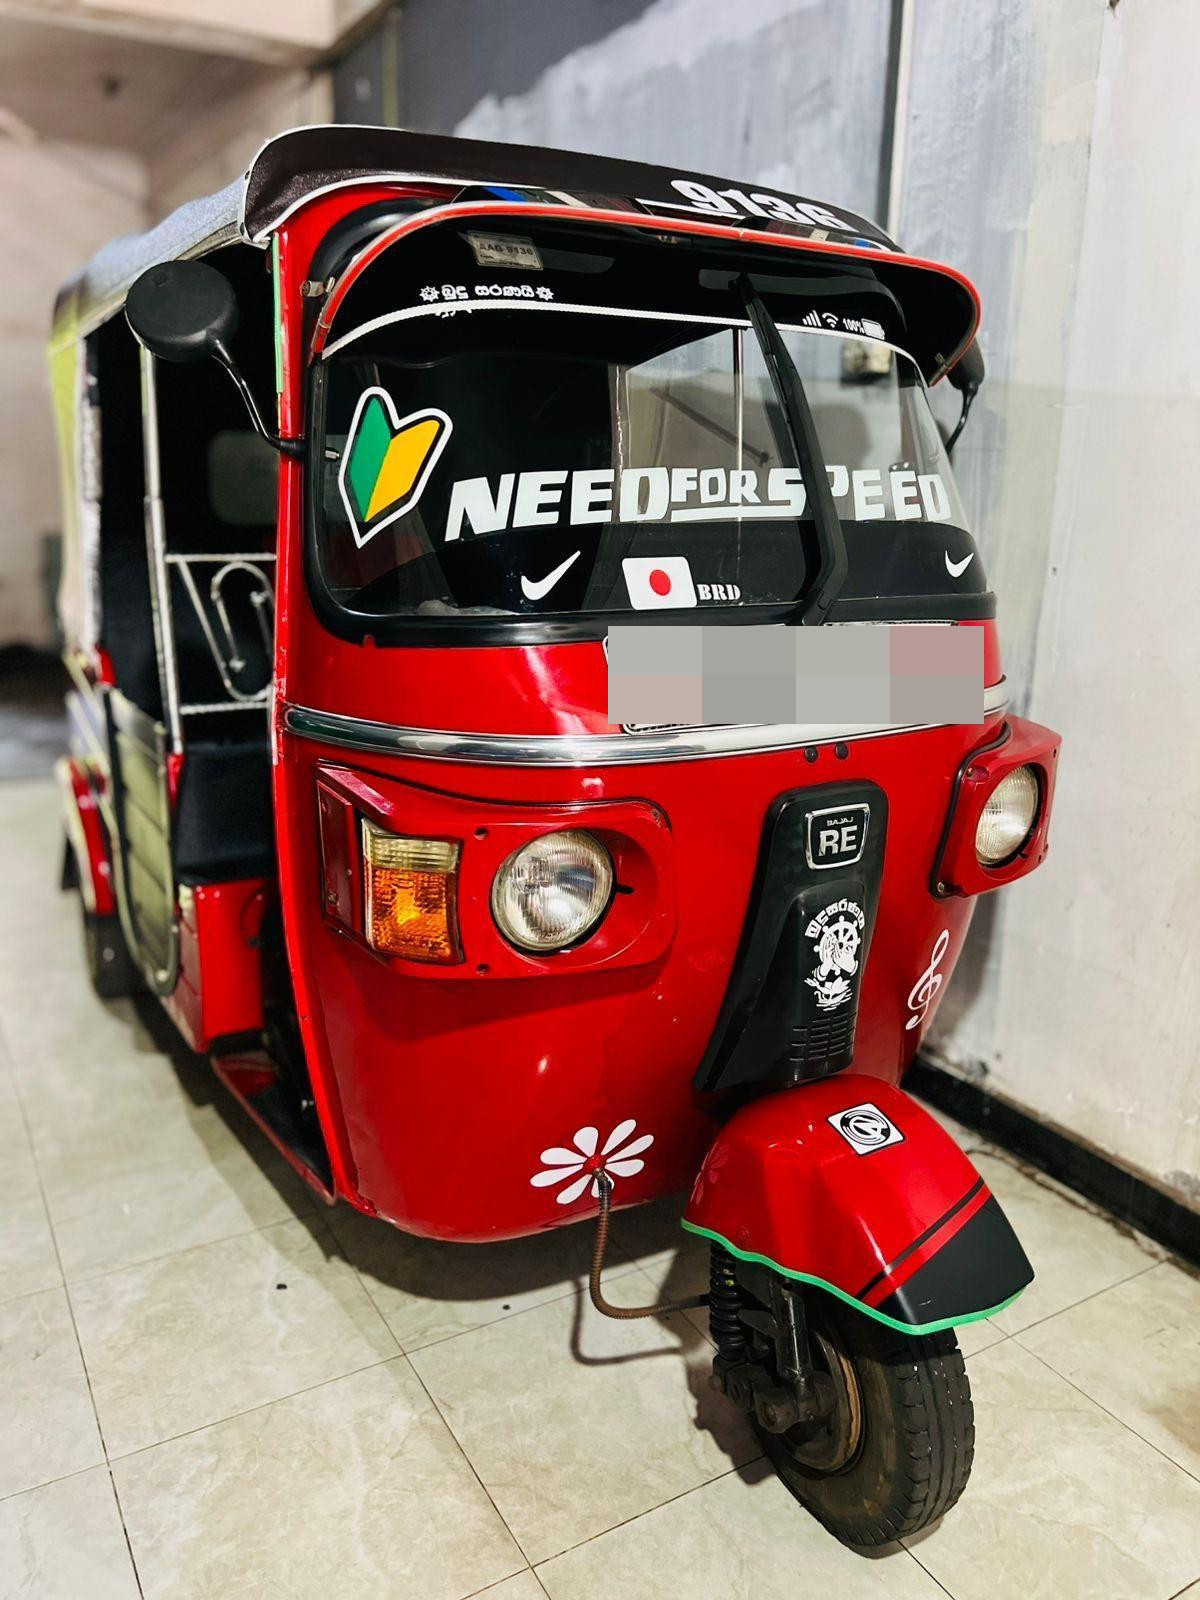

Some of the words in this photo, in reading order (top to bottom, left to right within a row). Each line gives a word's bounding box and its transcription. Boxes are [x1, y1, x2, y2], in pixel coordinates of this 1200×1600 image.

[670, 180, 859, 232] 9136
[843, 318, 865, 334] 100%
[445, 467, 670, 541] NEED
[671, 467, 761, 504] FOR
[697, 583, 741, 601] BRD
[826, 816, 854, 826] BAJAJ
[818, 825, 858, 857] RE
